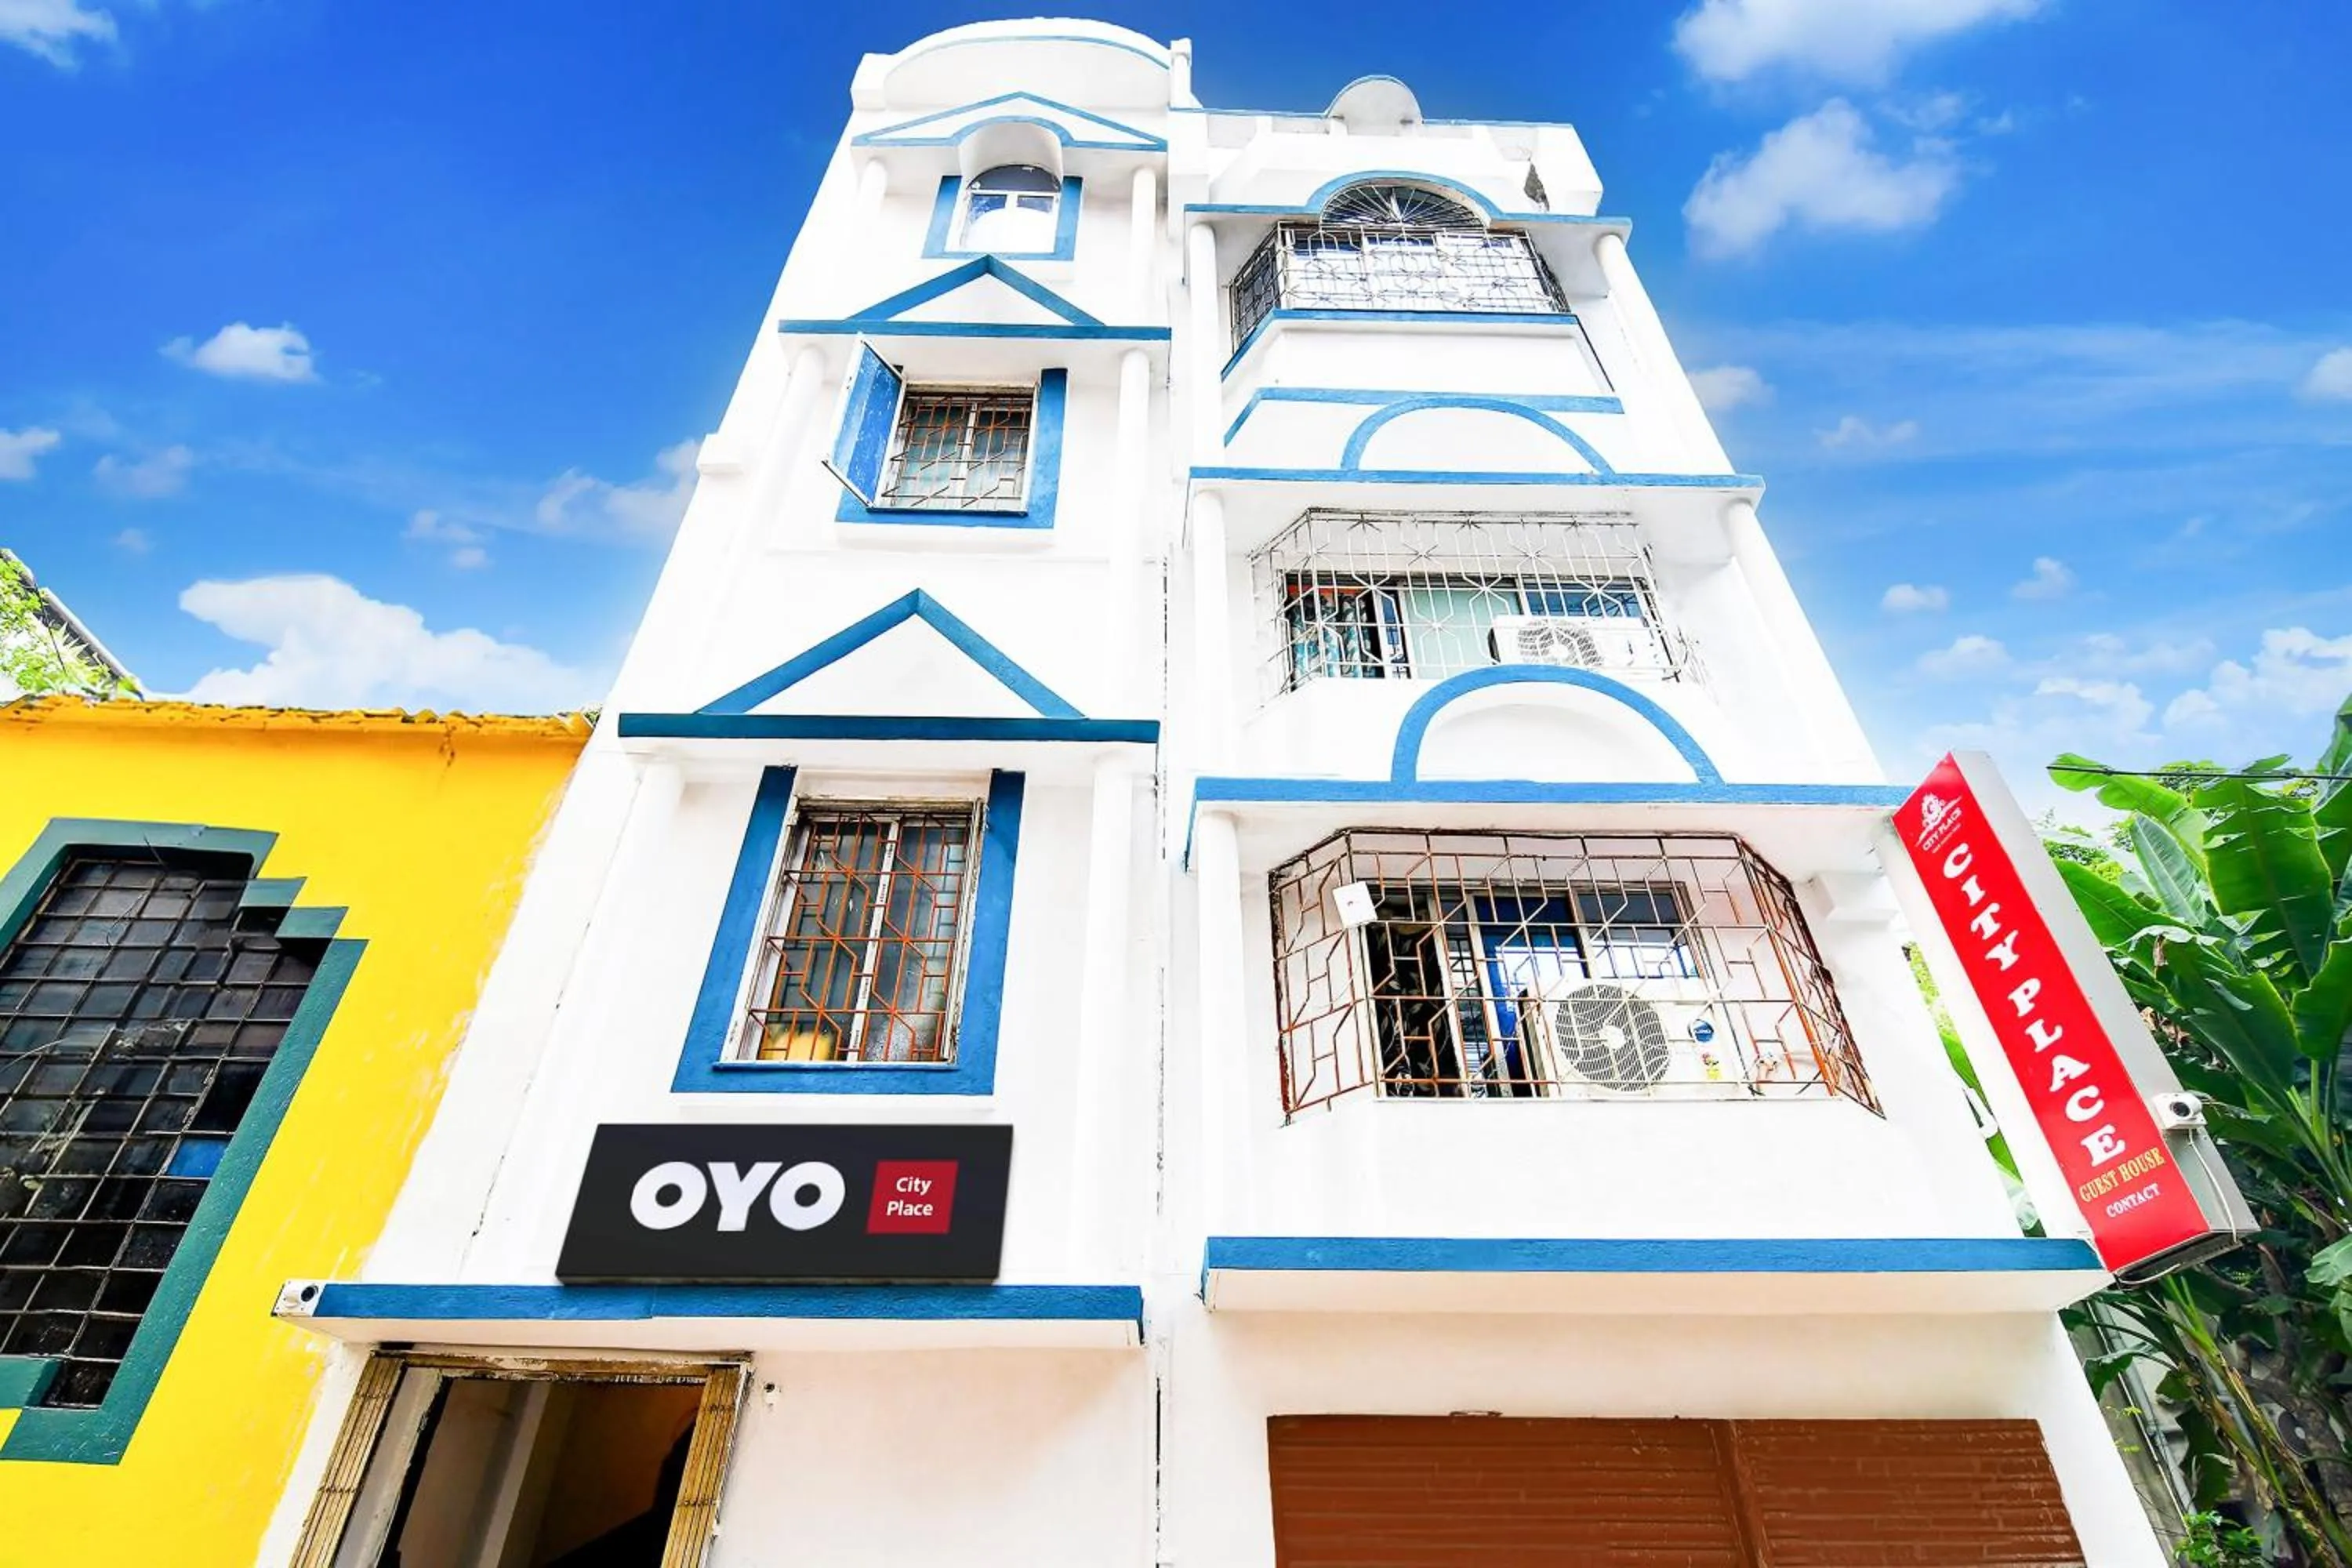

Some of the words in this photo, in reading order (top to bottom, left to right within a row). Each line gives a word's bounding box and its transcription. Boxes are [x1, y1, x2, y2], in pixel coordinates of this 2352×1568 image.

[1943, 842, 2019, 972] CITY
[2008, 977, 2125, 1167] PLACE
[630, 1161, 845, 1232] OYO
[896, 1176, 932, 1196] City
[2079, 1170, 2119, 1202] GUEST
[2118, 1147, 2165, 1182] HOUSE
[887, 1200, 934, 1216] Place
[2106, 1182, 2160, 1218] CONTACT
